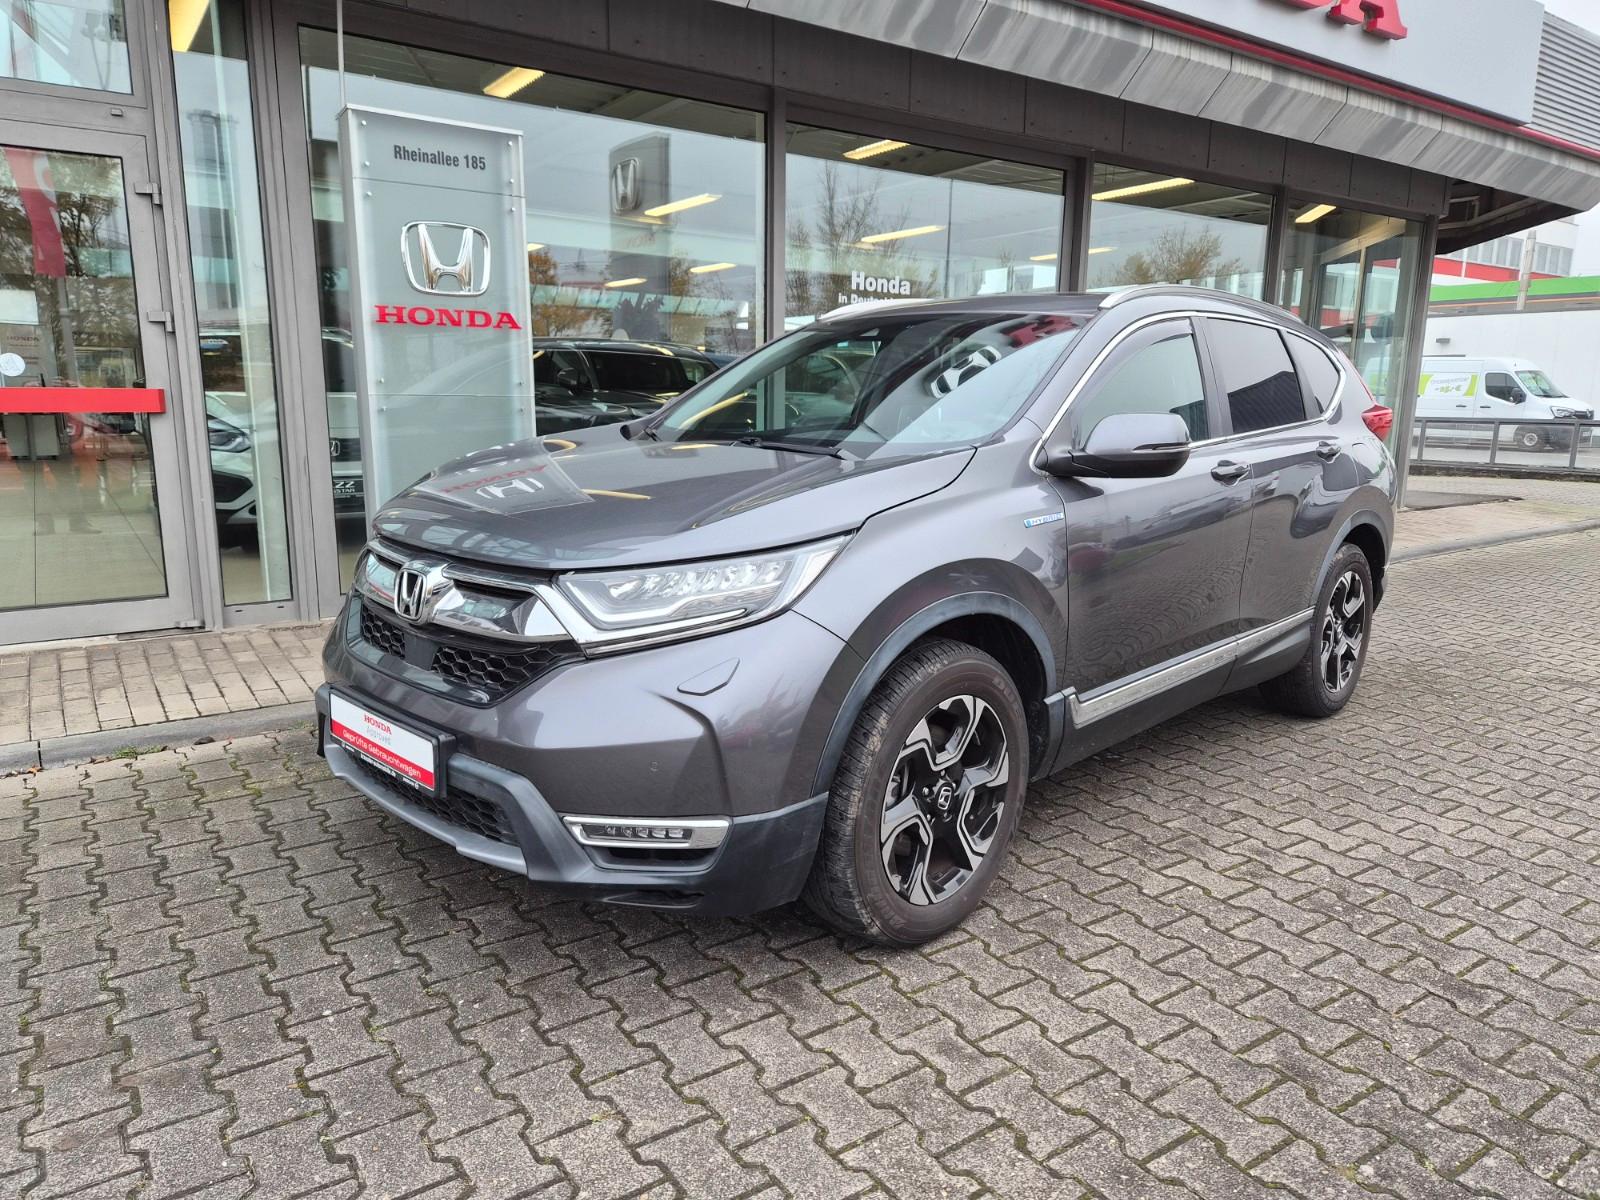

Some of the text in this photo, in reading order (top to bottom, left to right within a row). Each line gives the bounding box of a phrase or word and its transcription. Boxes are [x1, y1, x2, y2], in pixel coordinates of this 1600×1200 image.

[393, 144, 487, 171] Rheinallee 185
[851, 270, 911, 296] Honda
[838, 292, 848, 304] in
[374, 304, 523, 330] HONDA
[363, 713, 393, 735] HONDA
